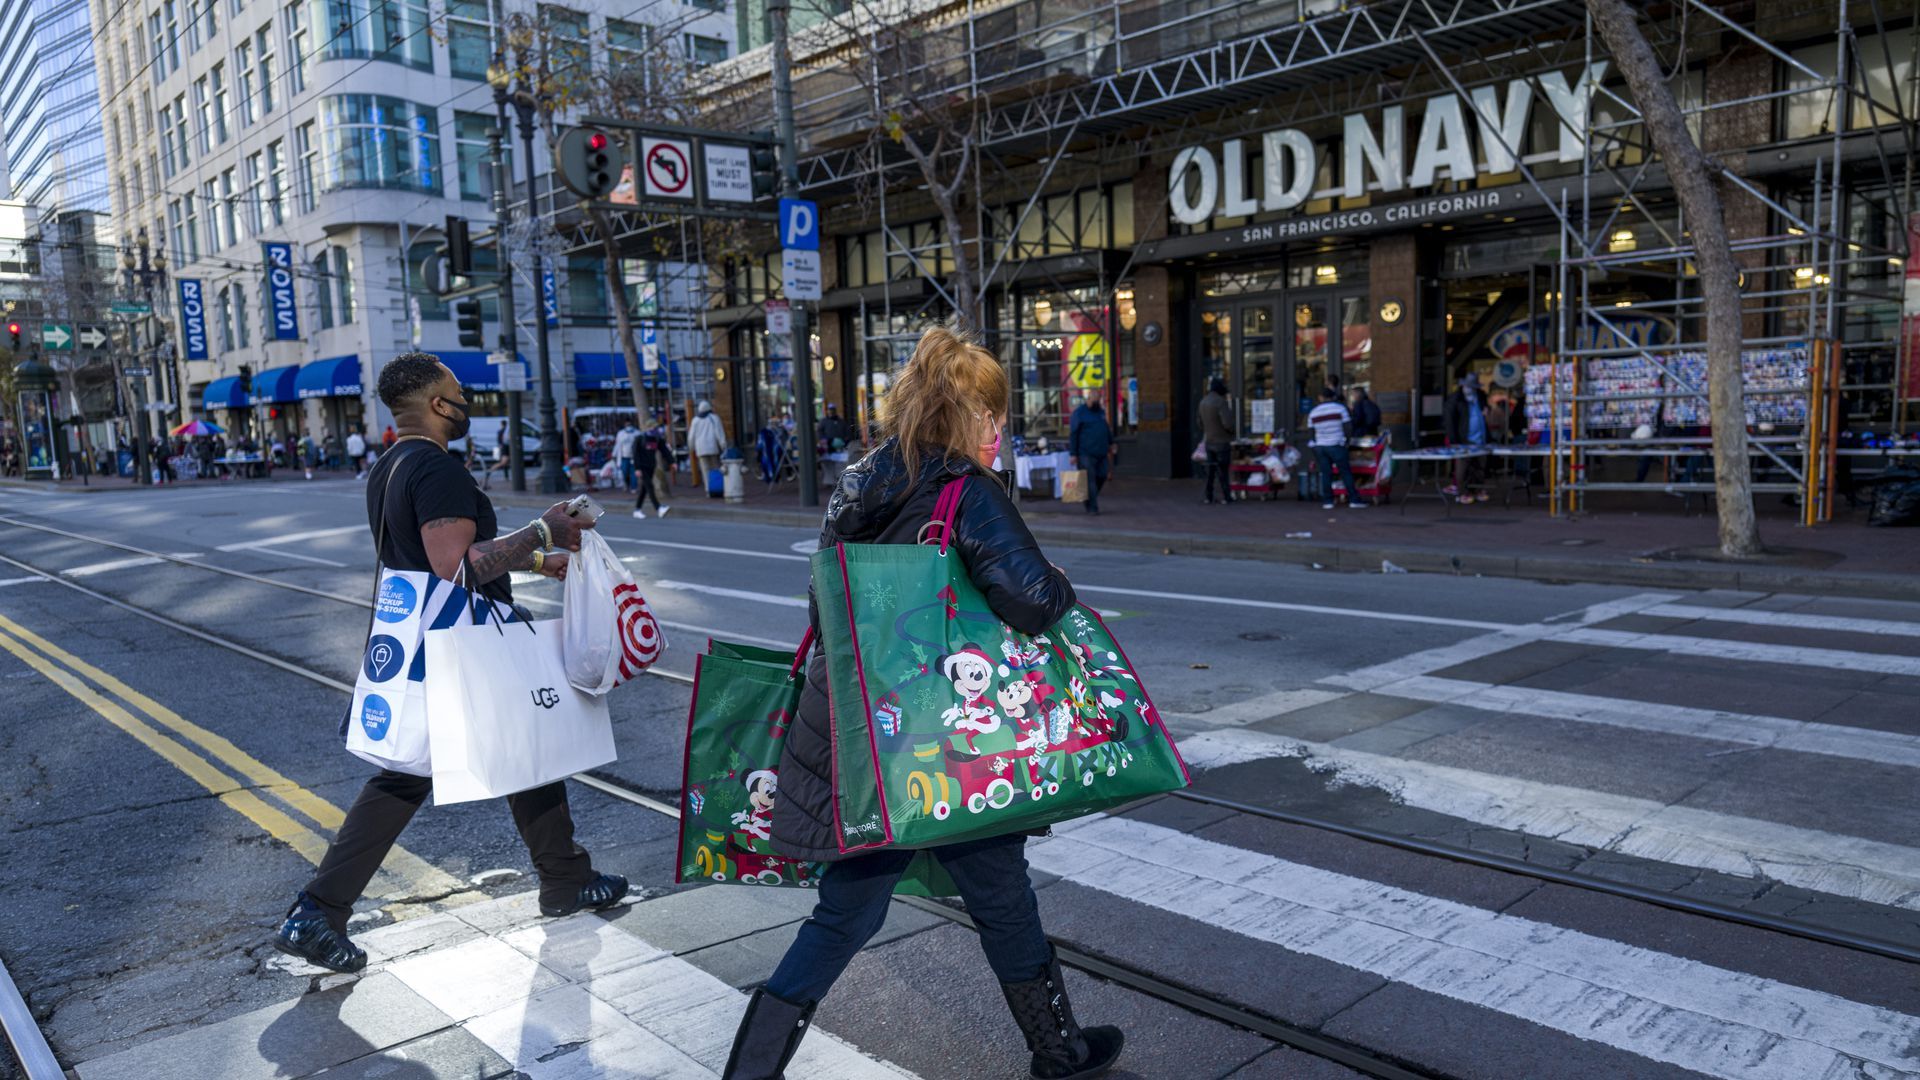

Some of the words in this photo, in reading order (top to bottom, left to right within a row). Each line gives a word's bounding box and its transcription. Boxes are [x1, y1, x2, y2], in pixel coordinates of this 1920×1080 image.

[1169, 127, 1317, 225] OLD
[1344, 61, 1609, 198] NAVY
[716, 168, 741, 180] MUST
[1242, 226, 1273, 243] SAN
[1385, 191, 1500, 222] CALIFORNIA
[271, 247, 294, 330] ROSS
[183, 282, 204, 352] ROSS
[334, 384, 361, 395] ROSS
[530, 687, 560, 709] UGG
